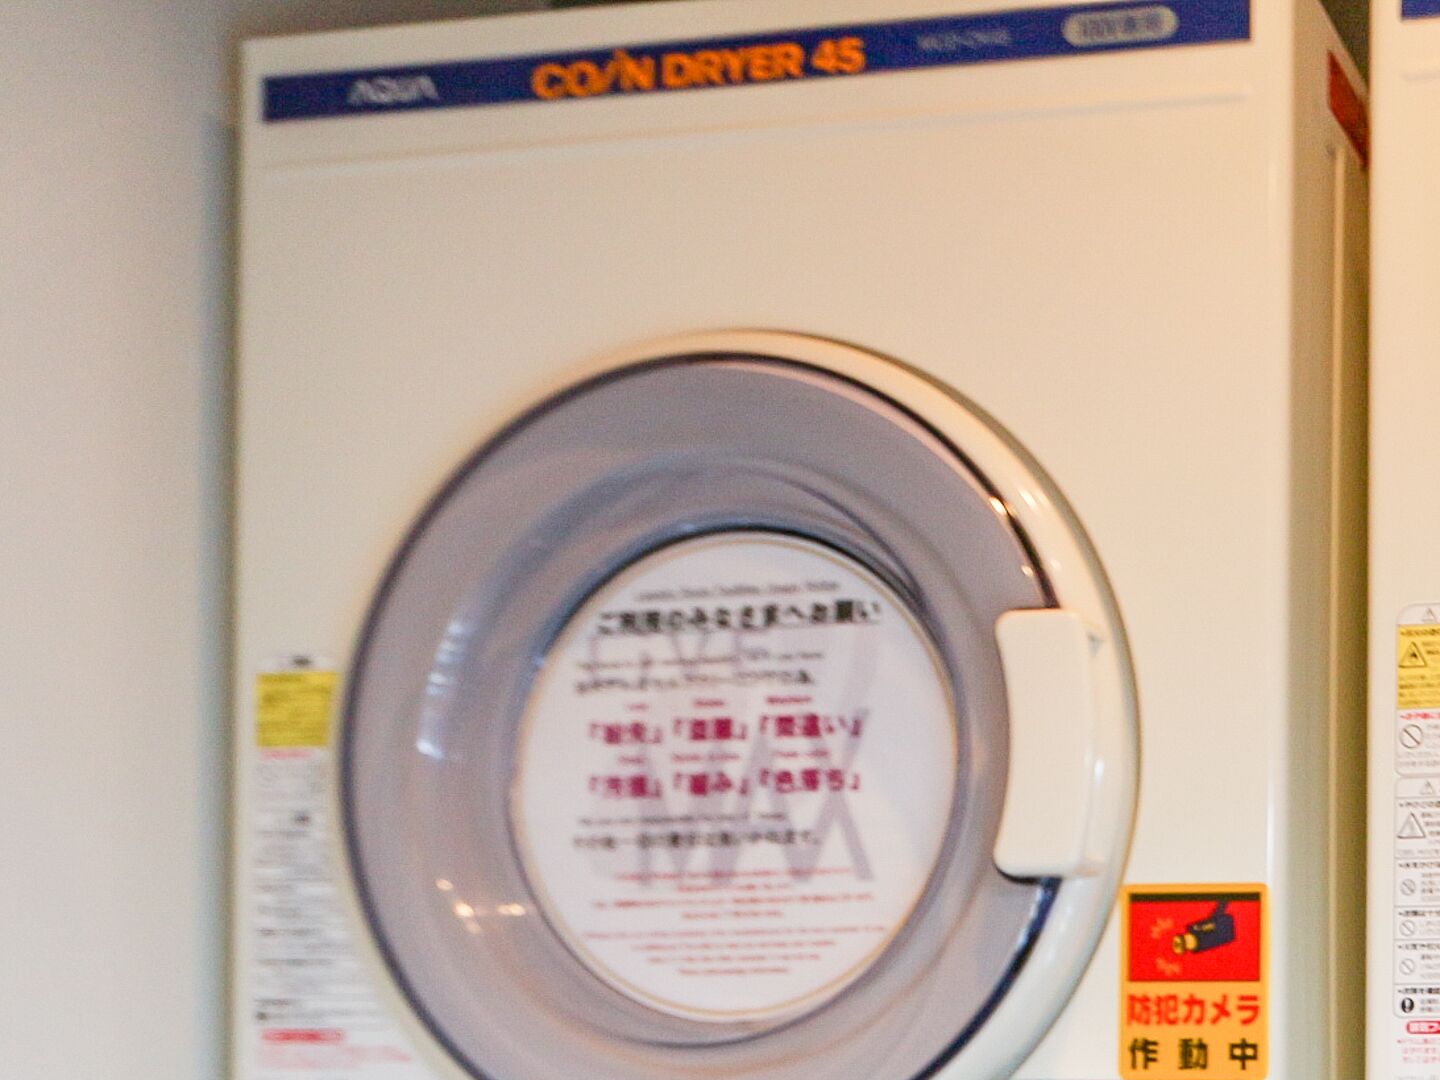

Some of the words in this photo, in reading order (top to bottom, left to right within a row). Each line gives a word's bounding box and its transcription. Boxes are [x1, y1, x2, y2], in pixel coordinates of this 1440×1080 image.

[660, 42, 804, 93] DRYER
[811, 36, 867, 75] 45
[1127, 993, 1260, 1027] 防犯カメラ
